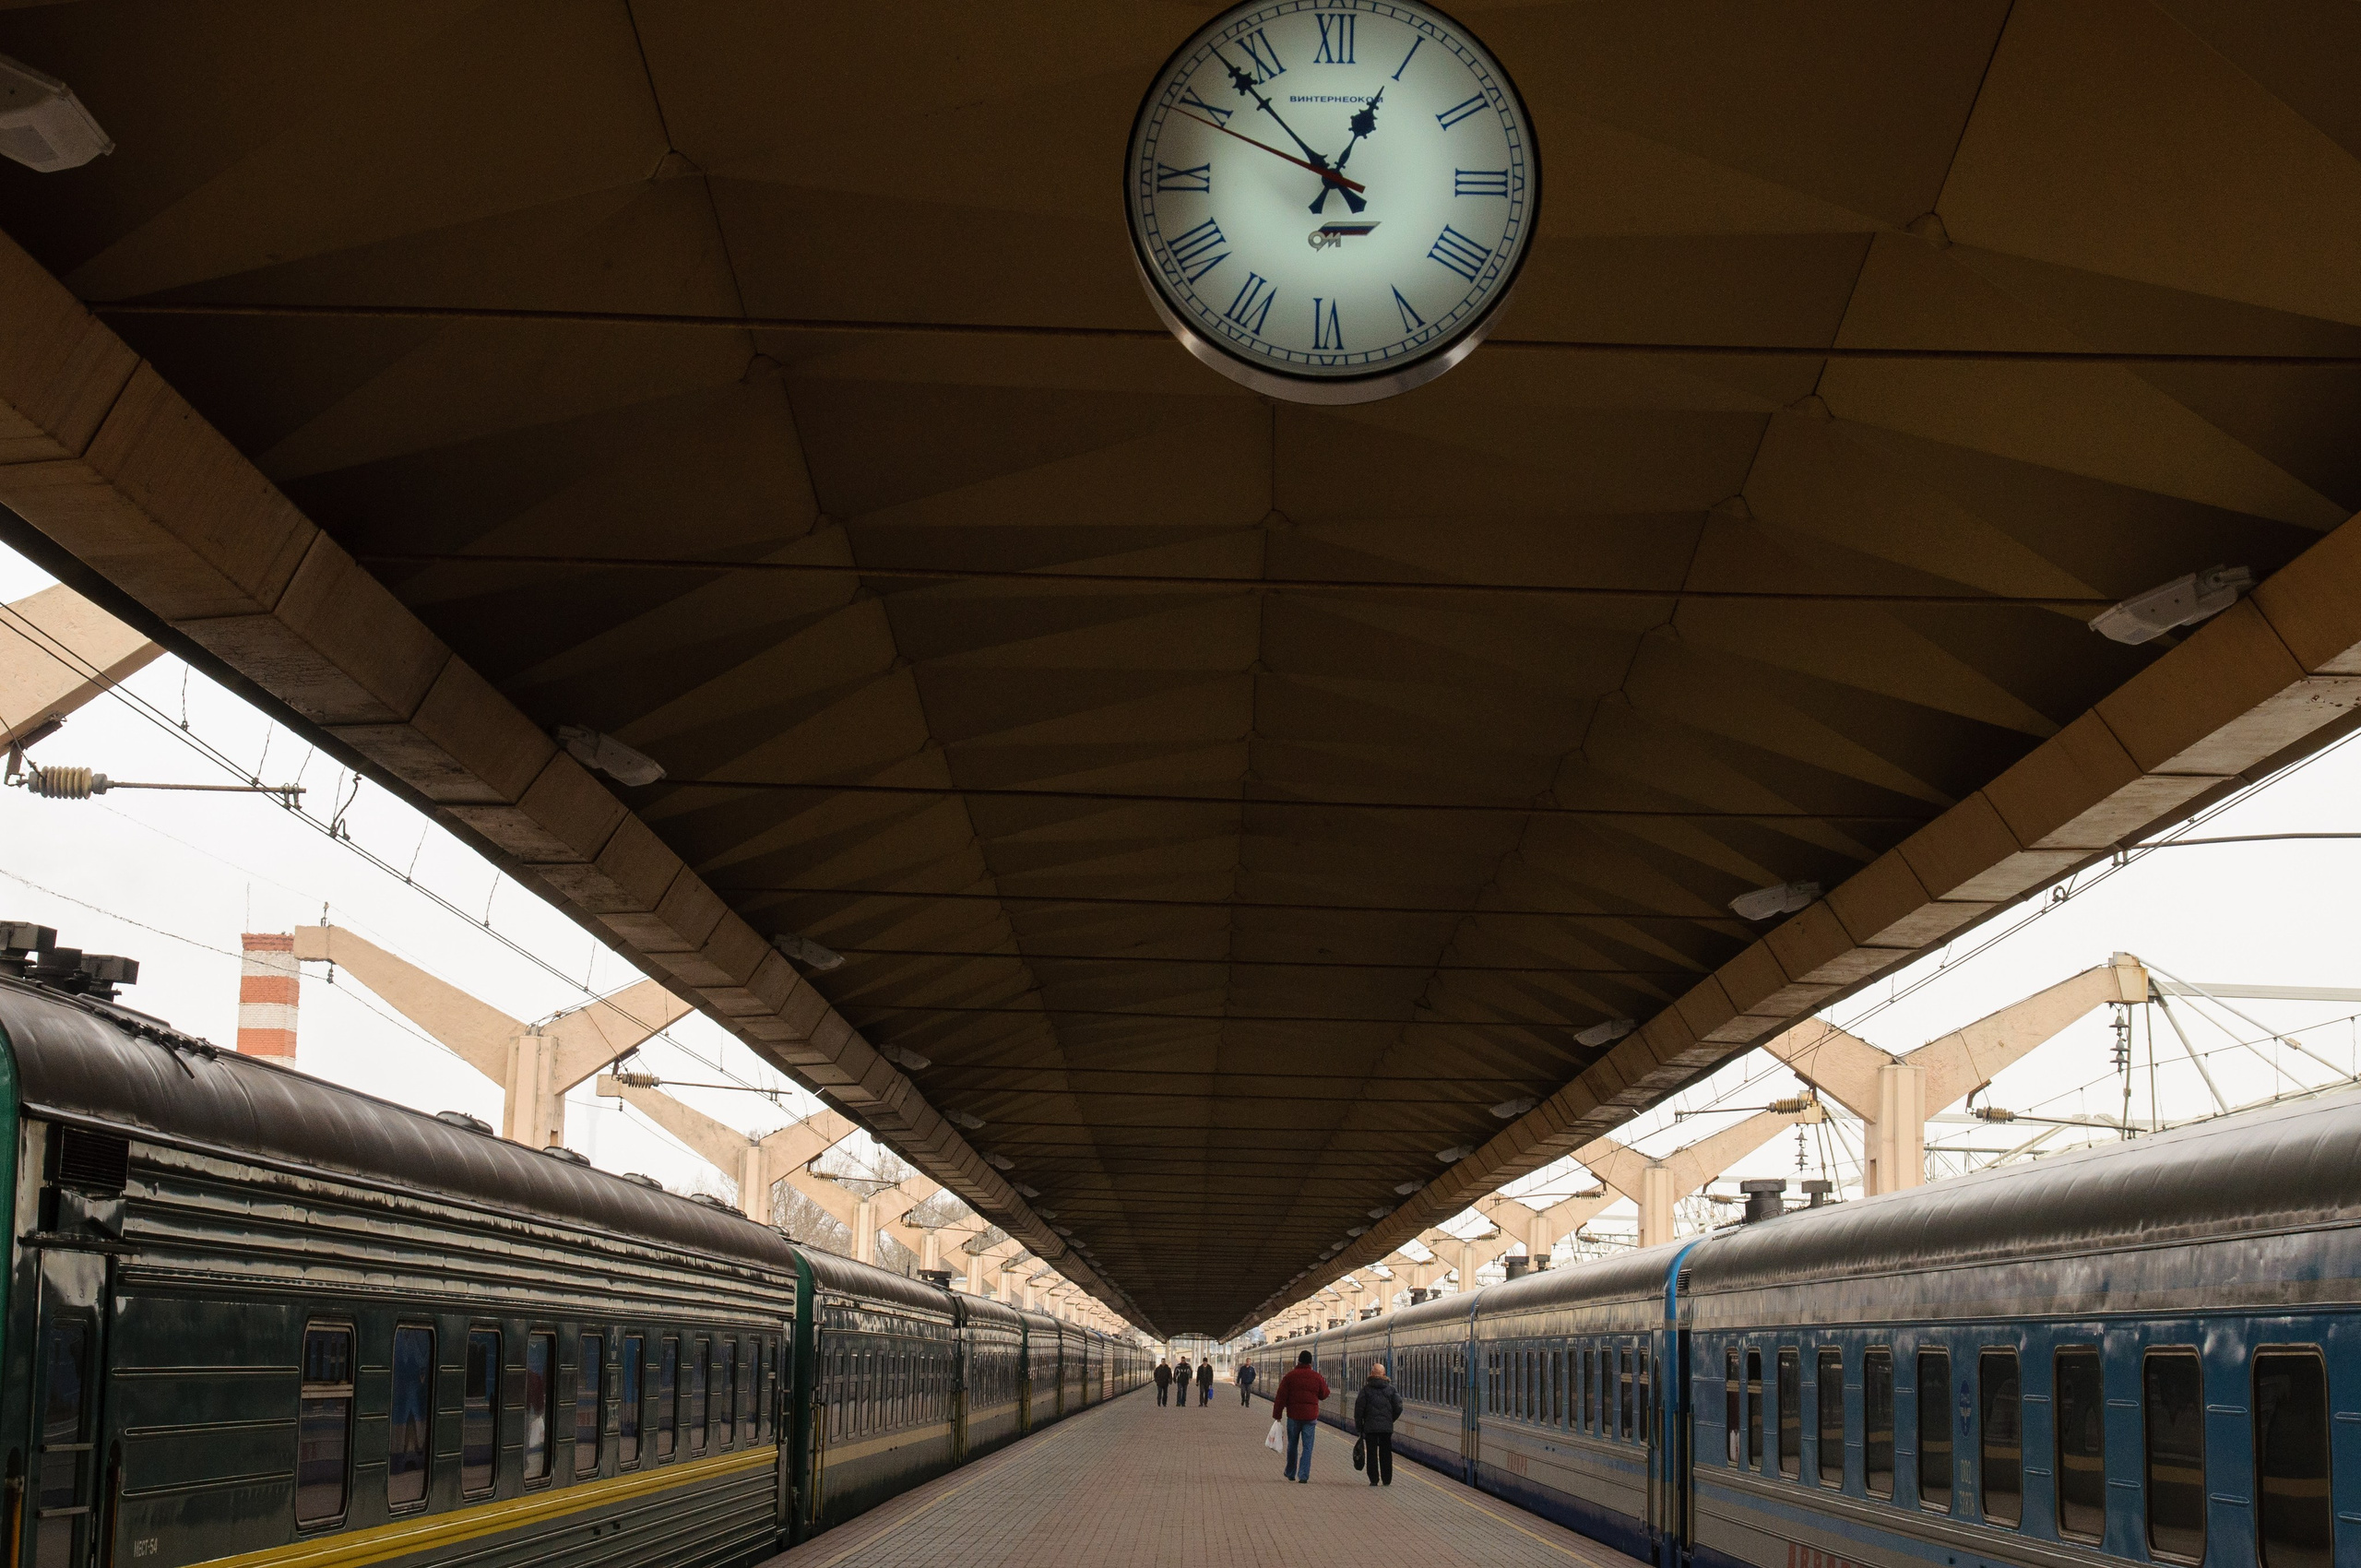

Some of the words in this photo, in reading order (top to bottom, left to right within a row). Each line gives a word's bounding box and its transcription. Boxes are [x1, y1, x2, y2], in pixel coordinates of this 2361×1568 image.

[1235, 28, 1287, 85] XI
[1312, 13, 1357, 65] XII
[1179, 86, 1234, 128] X
[1435, 90, 1490, 131] II
[1157, 162, 1211, 194] IX
[1454, 168, 1509, 198] III
[1167, 217, 1232, 286] VIII
[1223, 271, 1278, 336] VII
[1311, 298, 1345, 350] VI
[1391, 283, 1427, 334] V
